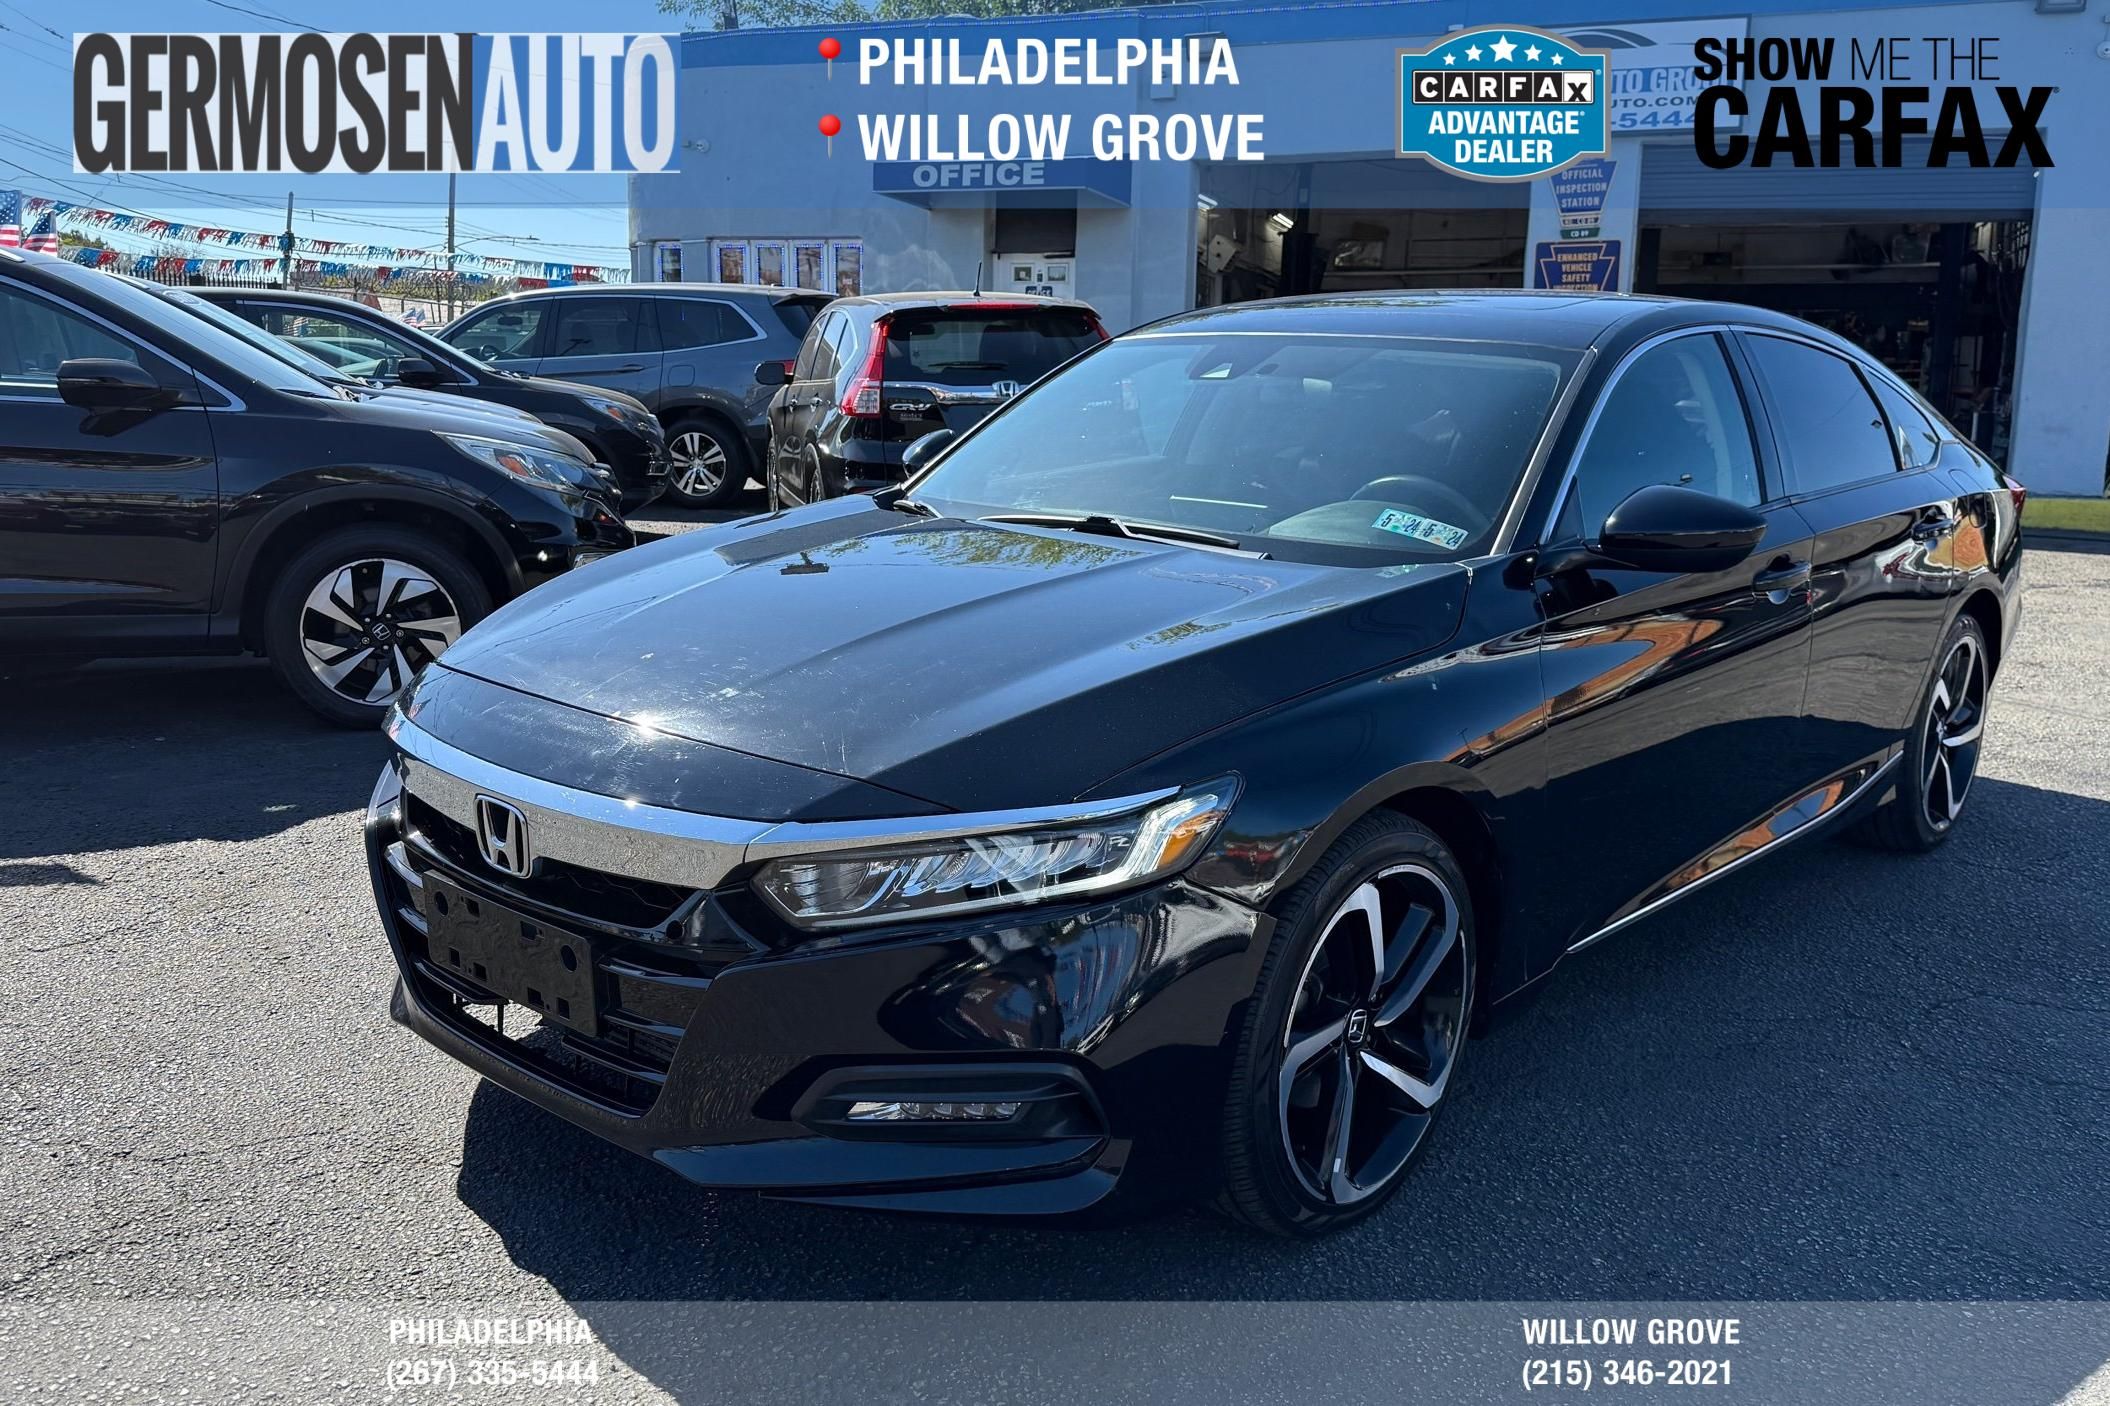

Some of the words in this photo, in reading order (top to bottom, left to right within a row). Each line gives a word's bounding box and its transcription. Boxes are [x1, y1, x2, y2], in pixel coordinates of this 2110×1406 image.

[912, 162, 1046, 187] OFFICE
[1561, 168, 1603, 180] OFFICIAL
[1556, 182, 1607, 194] INSPECTION
[1561, 197, 1600, 208] STATION
[1557, 253, 1598, 262] ENHANCED
[1561, 263, 1593, 272] VEHICLE
[1561, 273, 1592, 283] SAFETY
[1404, 519, 1420, 534] 24
[1446, 531, 1464, 547] 24
